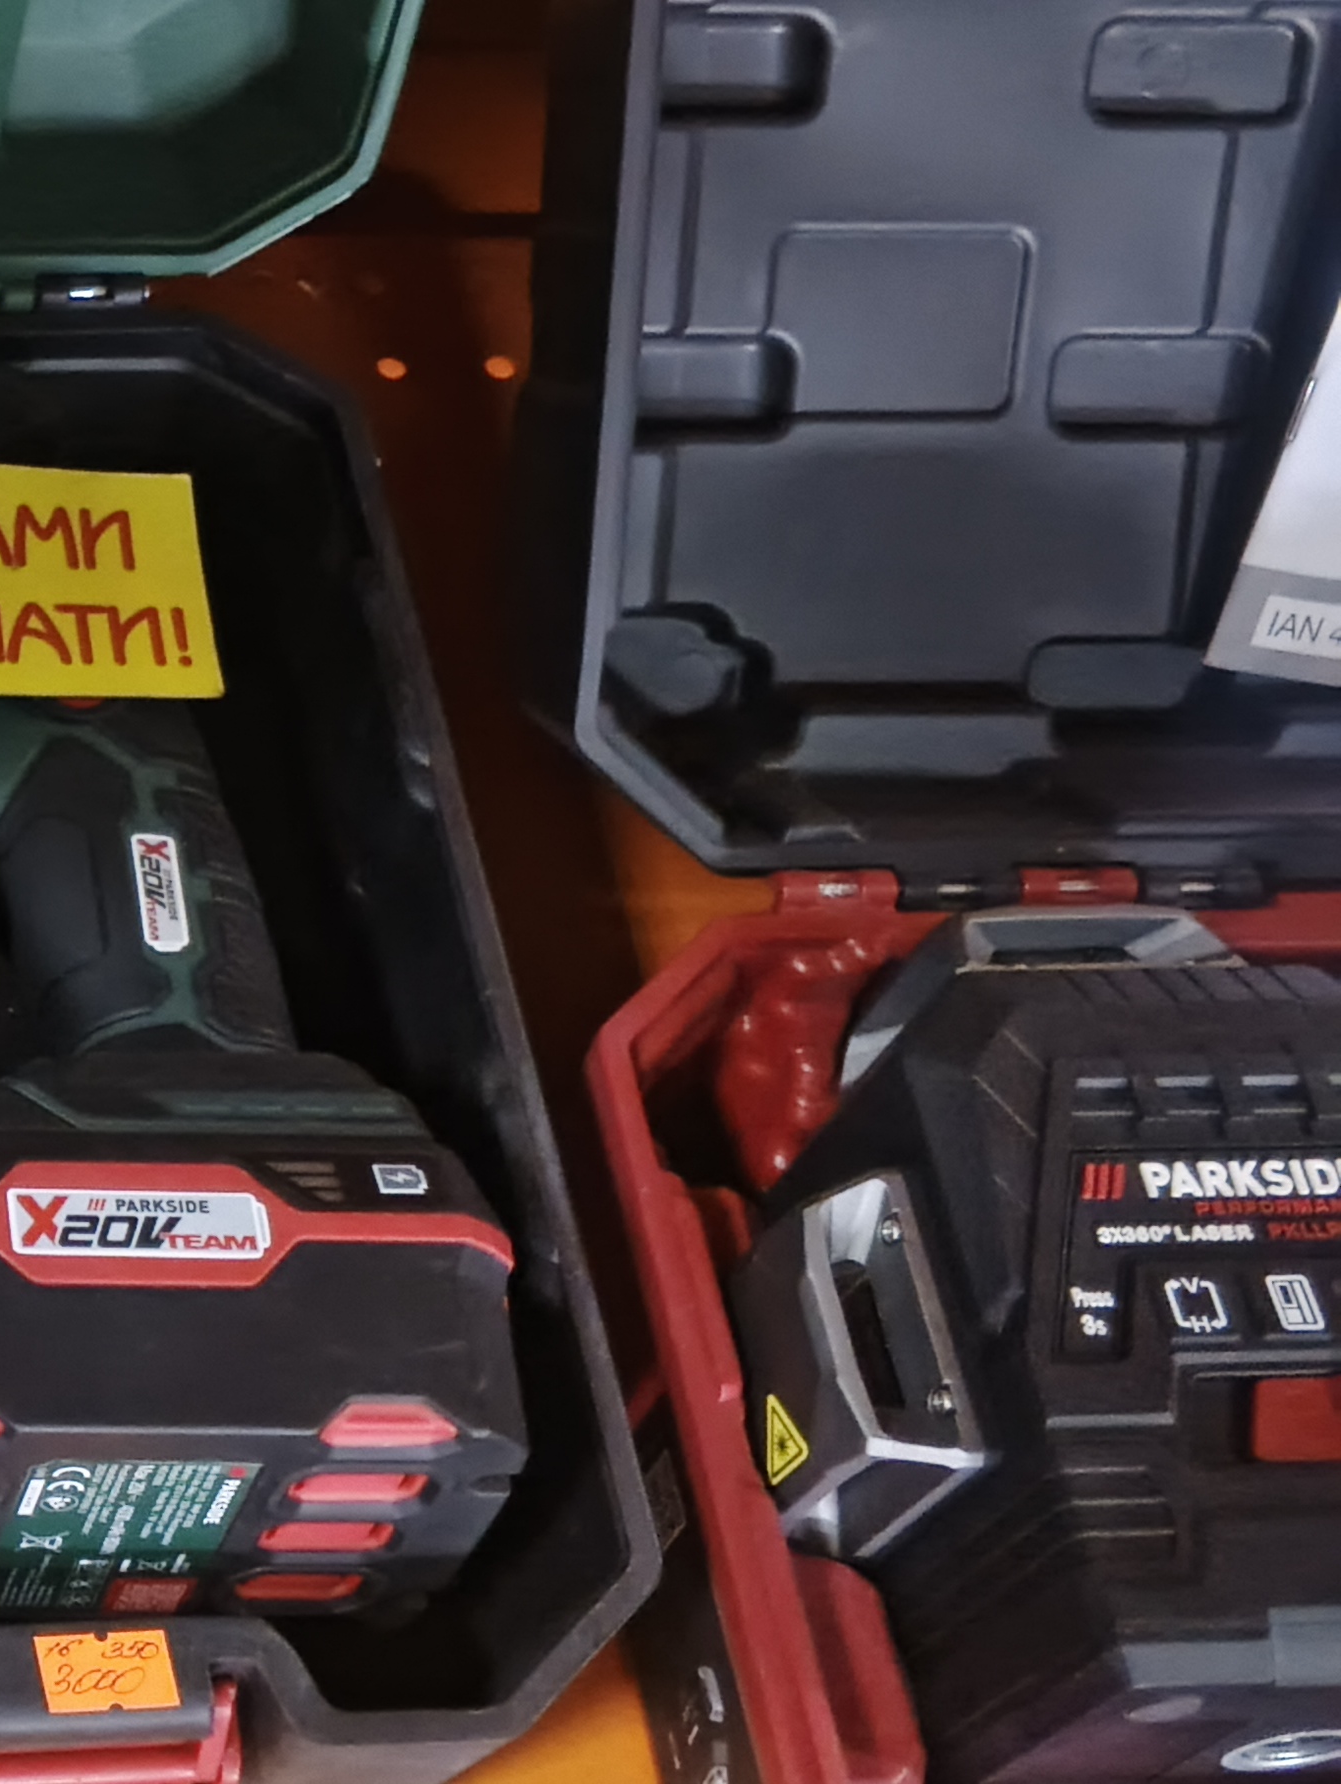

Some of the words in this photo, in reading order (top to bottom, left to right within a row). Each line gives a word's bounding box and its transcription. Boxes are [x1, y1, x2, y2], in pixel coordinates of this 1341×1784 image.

[1266, 609, 1325, 642] IAN
[1139, 1159, 1341, 1199] PARKSID
[115, 1198, 210, 1214] PARKSIDE
[161, 1234, 257, 1250] TEAM
[1174, 1223, 1254, 1242] LASER
[1070, 1286, 1115, 1308] Press
[203, 1478, 241, 1525] PARKSIDE
